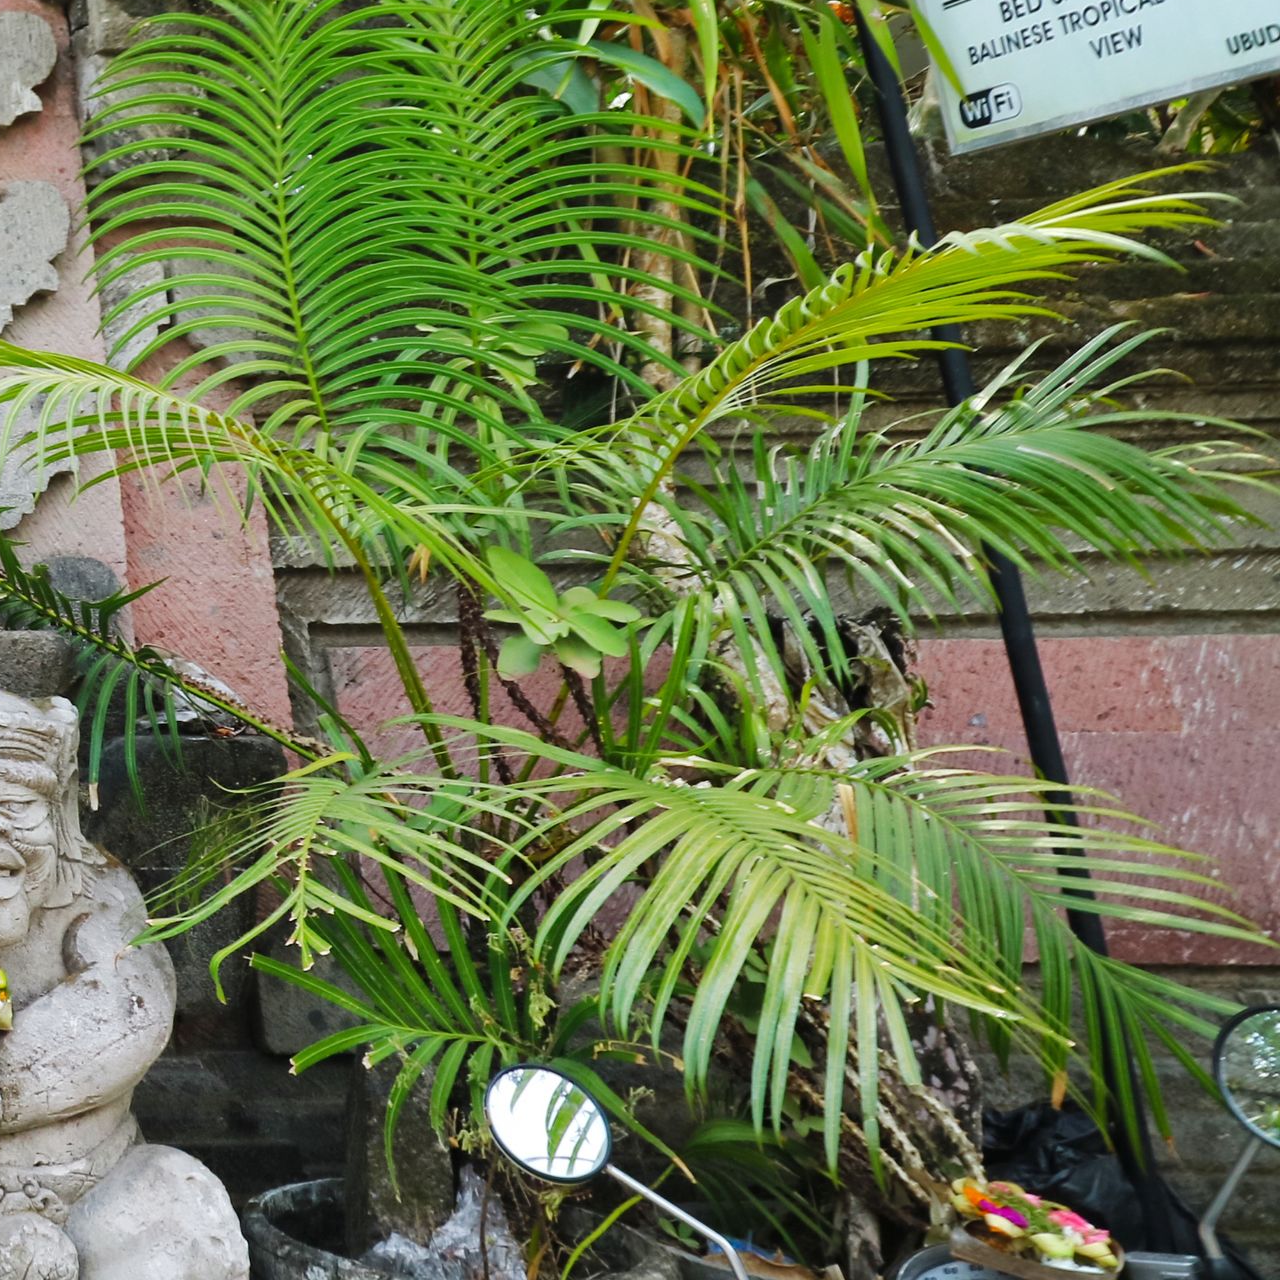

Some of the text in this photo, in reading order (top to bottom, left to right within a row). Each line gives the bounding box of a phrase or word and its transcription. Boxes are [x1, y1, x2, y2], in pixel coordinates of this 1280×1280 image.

[968, 20, 1055, 65] BALINESE
[1088, 24, 1143, 59] VIEW
[1226, 23, 1280, 55] UBUD
